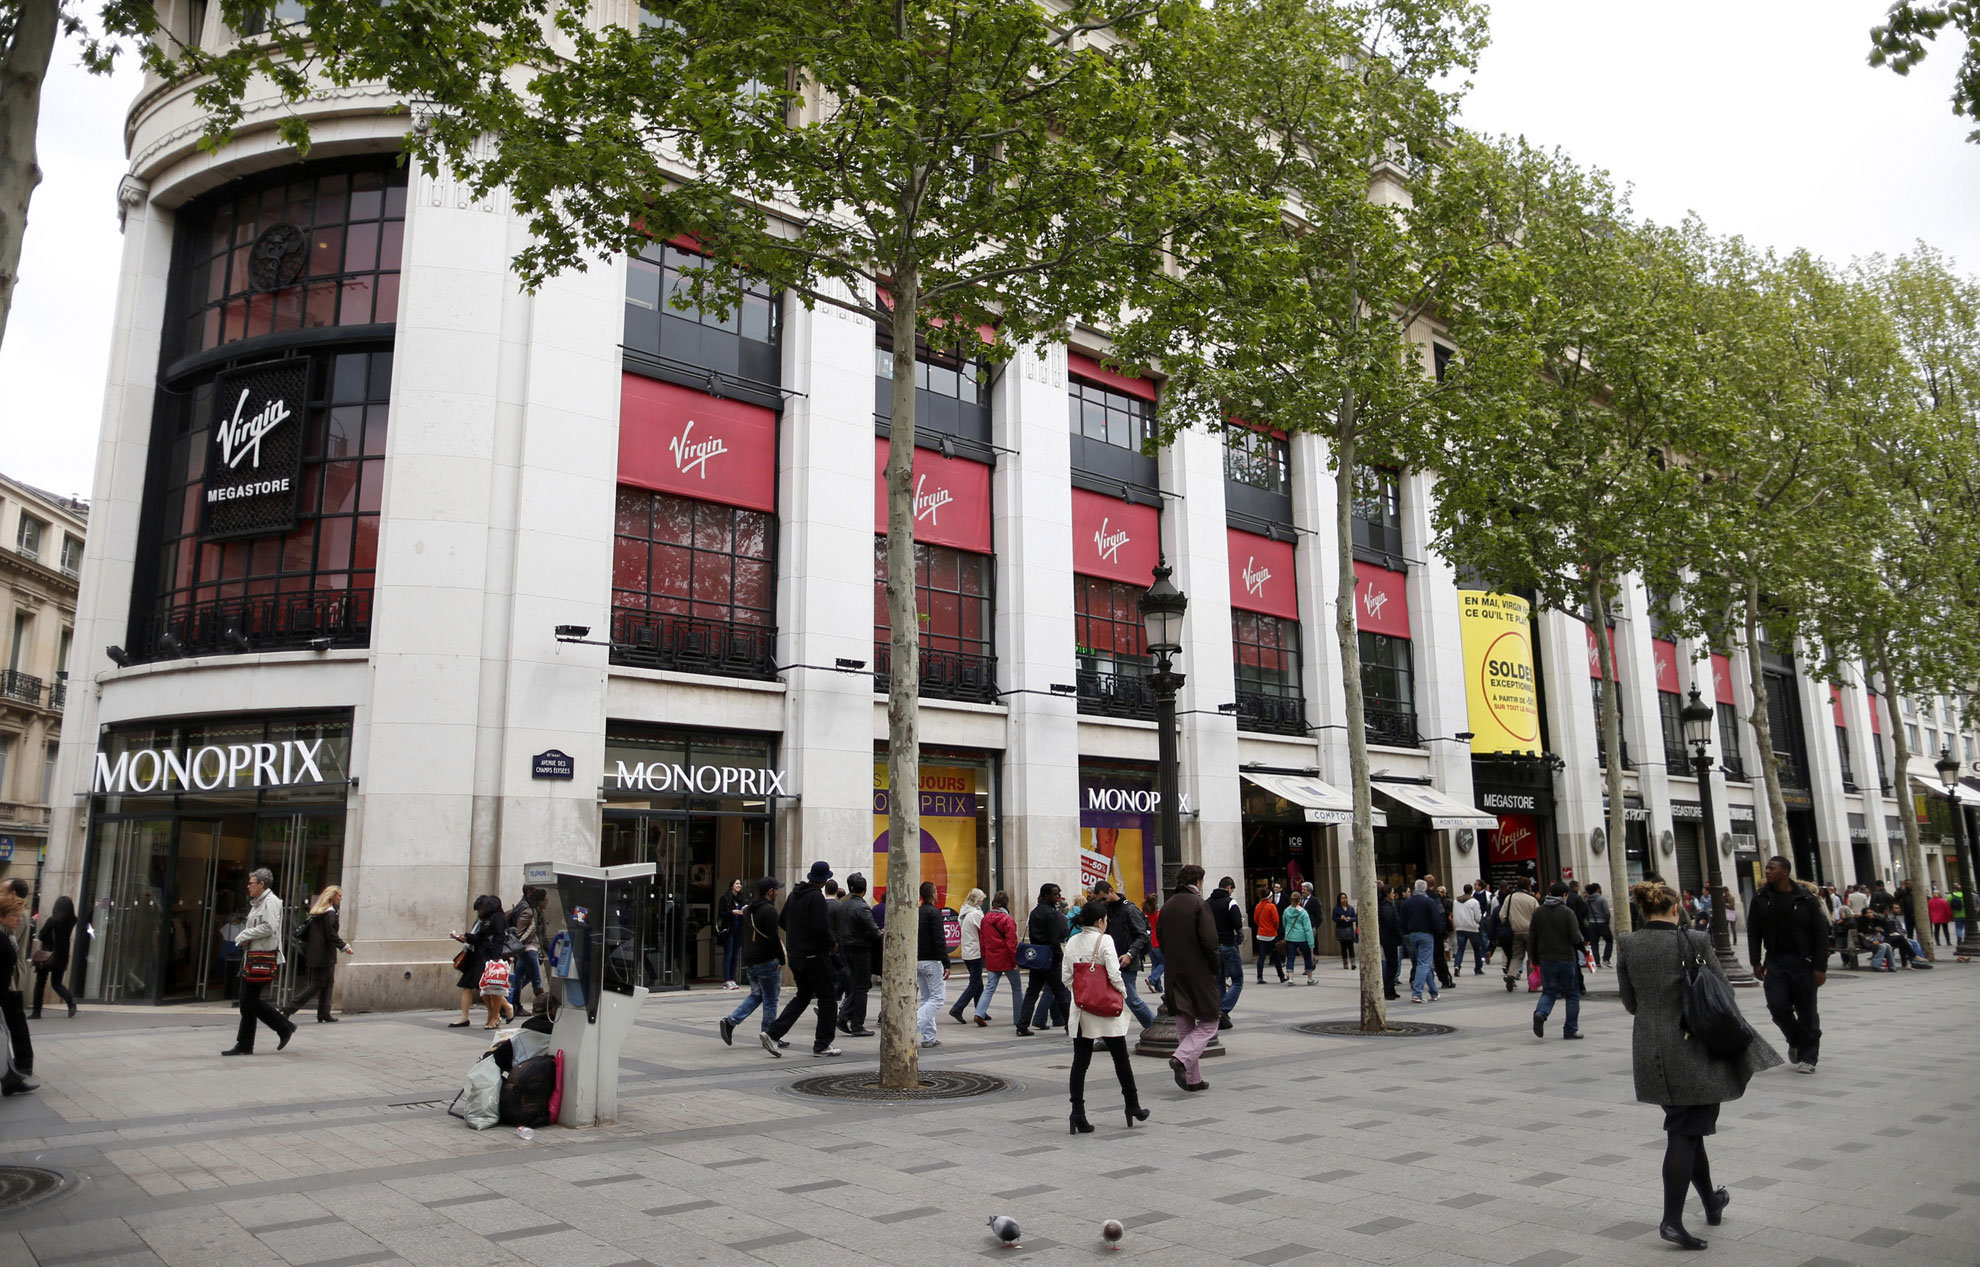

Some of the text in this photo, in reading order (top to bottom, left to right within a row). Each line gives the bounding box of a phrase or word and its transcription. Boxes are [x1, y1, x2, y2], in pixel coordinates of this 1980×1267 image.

[217, 389, 290, 468] Virgin
[669, 420, 728, 479] Virgin
[207, 478, 290, 502] MEGASTORE
[1094, 517, 1130, 564] Virgin
[1242, 556, 1272, 598] Virgin
[1363, 582, 1388, 620] Virgin
[1465, 597, 1478, 606] EN
[1481, 597, 1500, 609] MAI,
[1501, 600, 1522, 612] VIRGIN
[1465, 609, 1479, 618] CE
[1482, 610, 1503, 620] QU'IL
[1505, 613, 1514, 622] TE
[94, 738, 324, 793] MONOPRIX
[616, 760, 786, 795] MONOPRIX
[1087, 787, 1189, 813] MONOPX
[1483, 793, 1535, 809] MEGASTORE
[1491, 821, 1531, 855] Virgin
[943, 924, 960, 938] 5%
